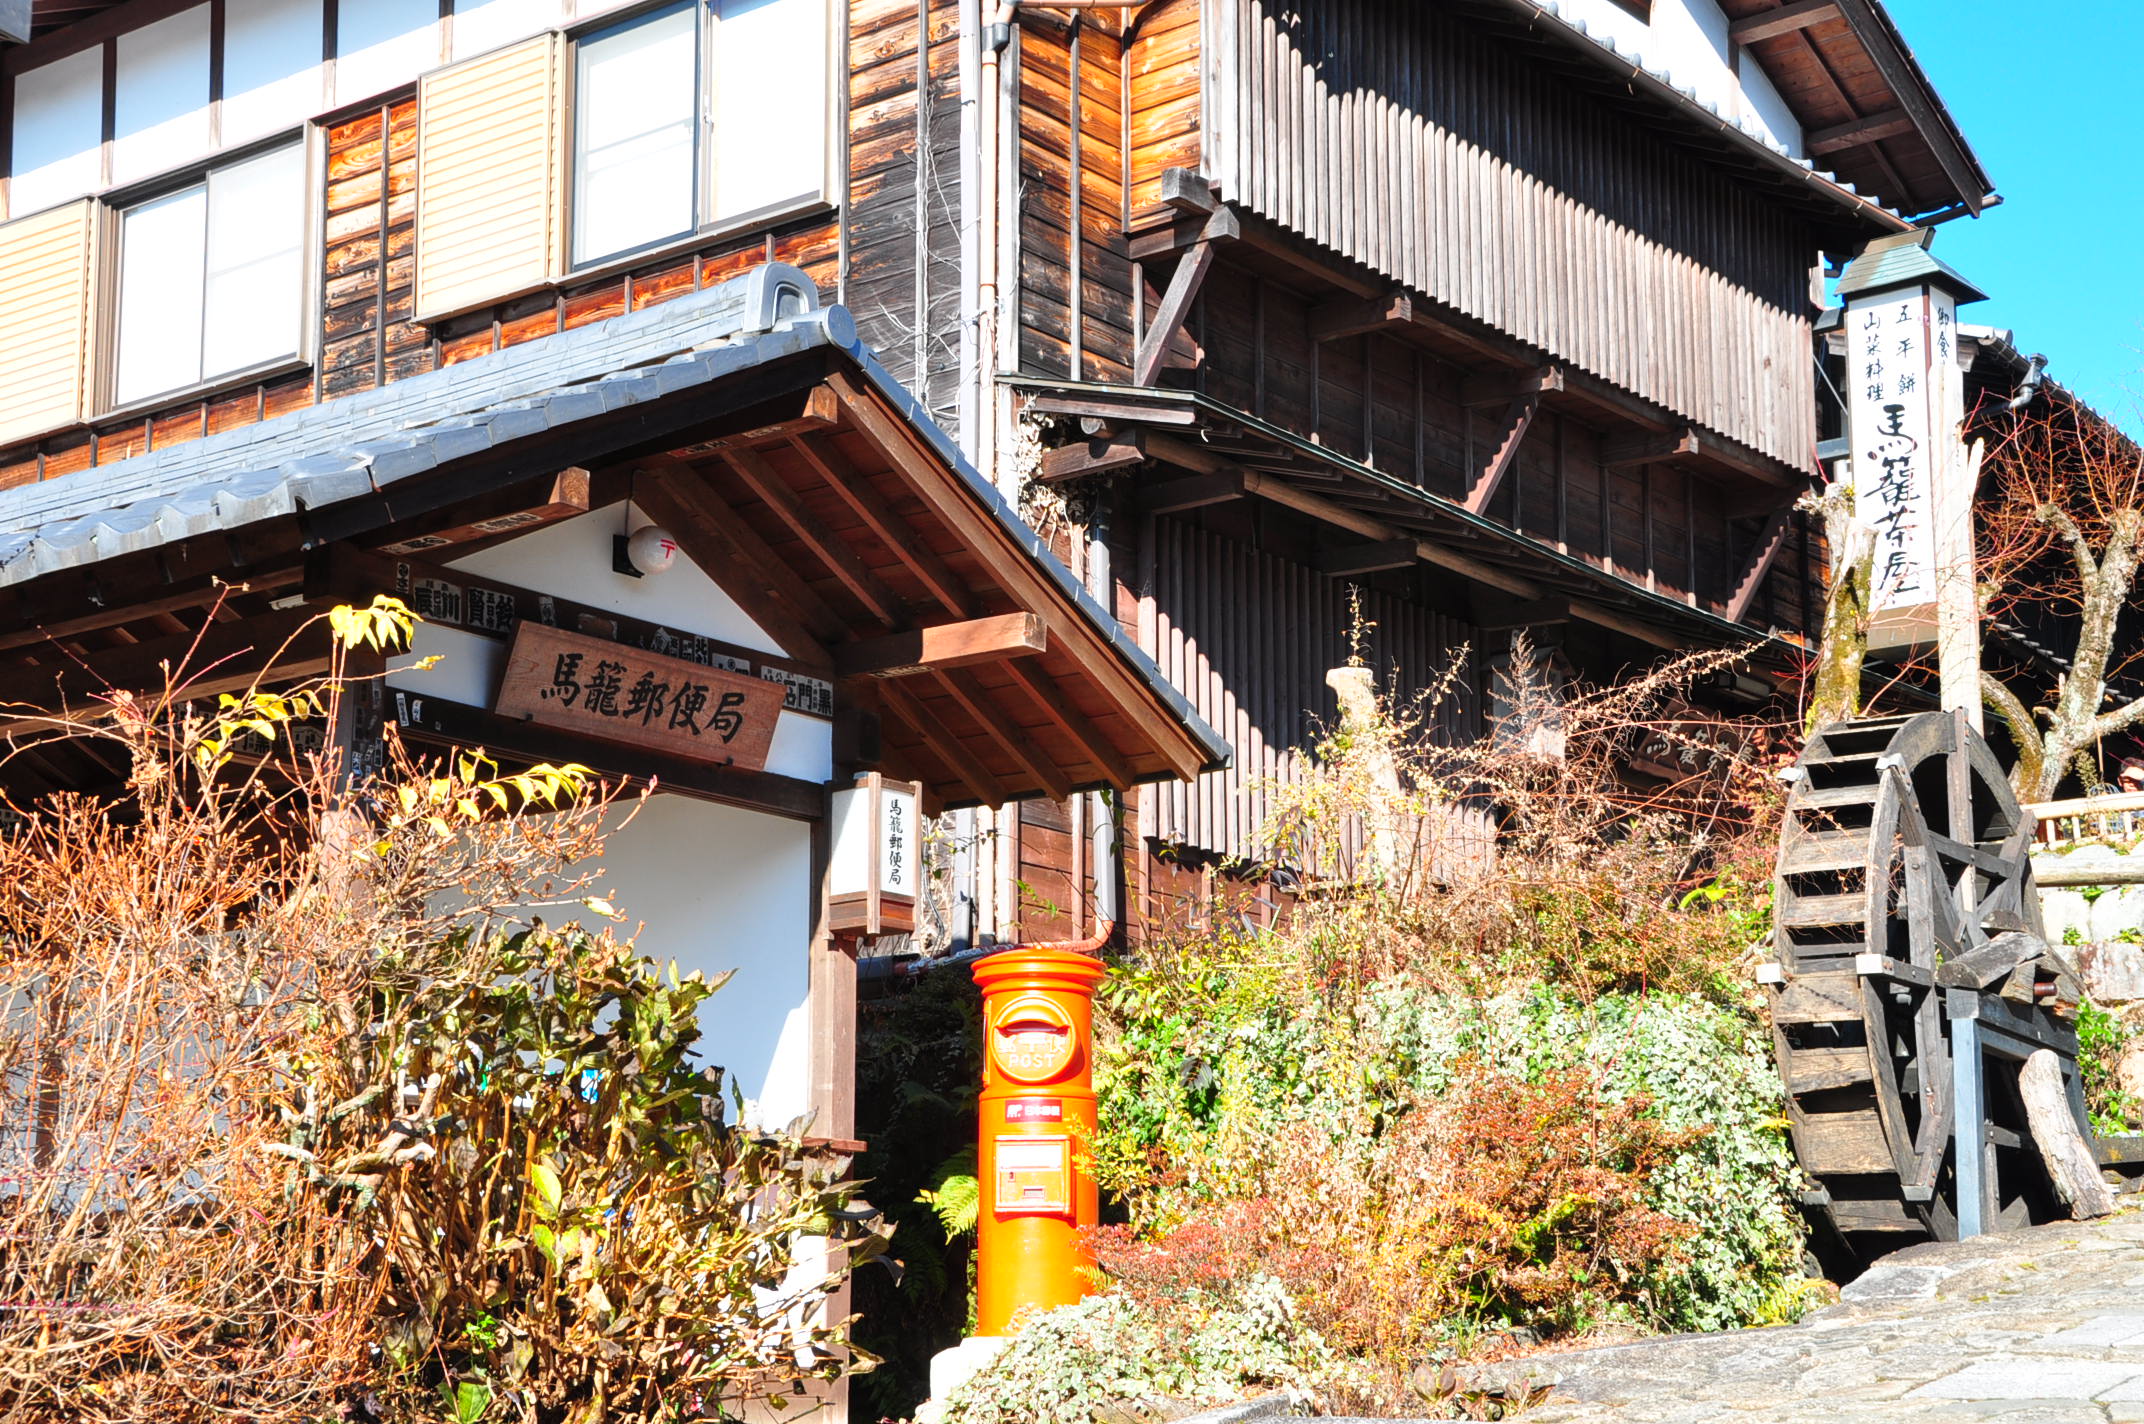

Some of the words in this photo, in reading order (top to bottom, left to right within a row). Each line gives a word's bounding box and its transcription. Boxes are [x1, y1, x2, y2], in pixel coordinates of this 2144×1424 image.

[1863, 311, 1885, 402] 山菜料理
[1896, 304, 1916, 396] 五平餅
[1936, 305, 1950, 366] 御食
[1863, 404, 1922, 594] 馬籠茶屋
[540, 652, 746, 744] 馬籠郵便局
[888, 798, 904, 886] 馬籠郵便局
[1008, 1053, 1056, 1068] POST
